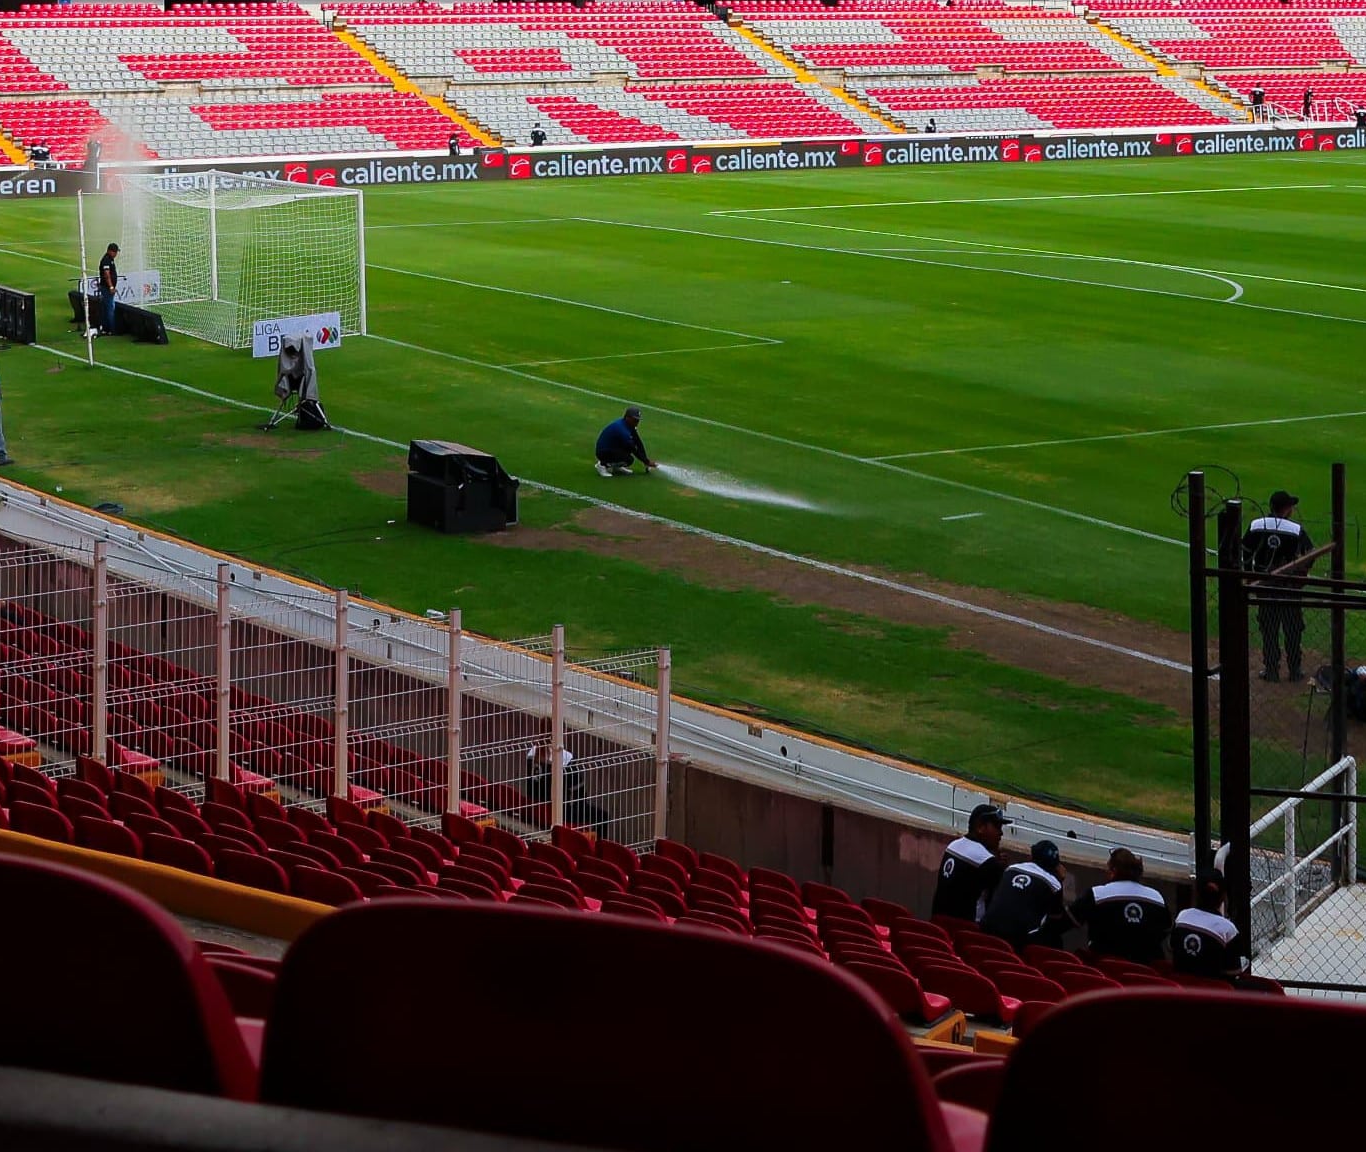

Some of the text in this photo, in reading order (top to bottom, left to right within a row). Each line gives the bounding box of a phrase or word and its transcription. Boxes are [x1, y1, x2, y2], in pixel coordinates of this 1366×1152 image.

[886, 142, 999, 164] caliente.mx
[1046, 138, 1151, 160] caliente.mx
[1196, 134, 1295, 154] caliente.mx
[535, 154, 663, 177] caliente.mx
[716, 149, 835, 170] caliente.mx
[341, 160, 478, 185] caliente.mx
[255, 323, 281, 336] LIGA
